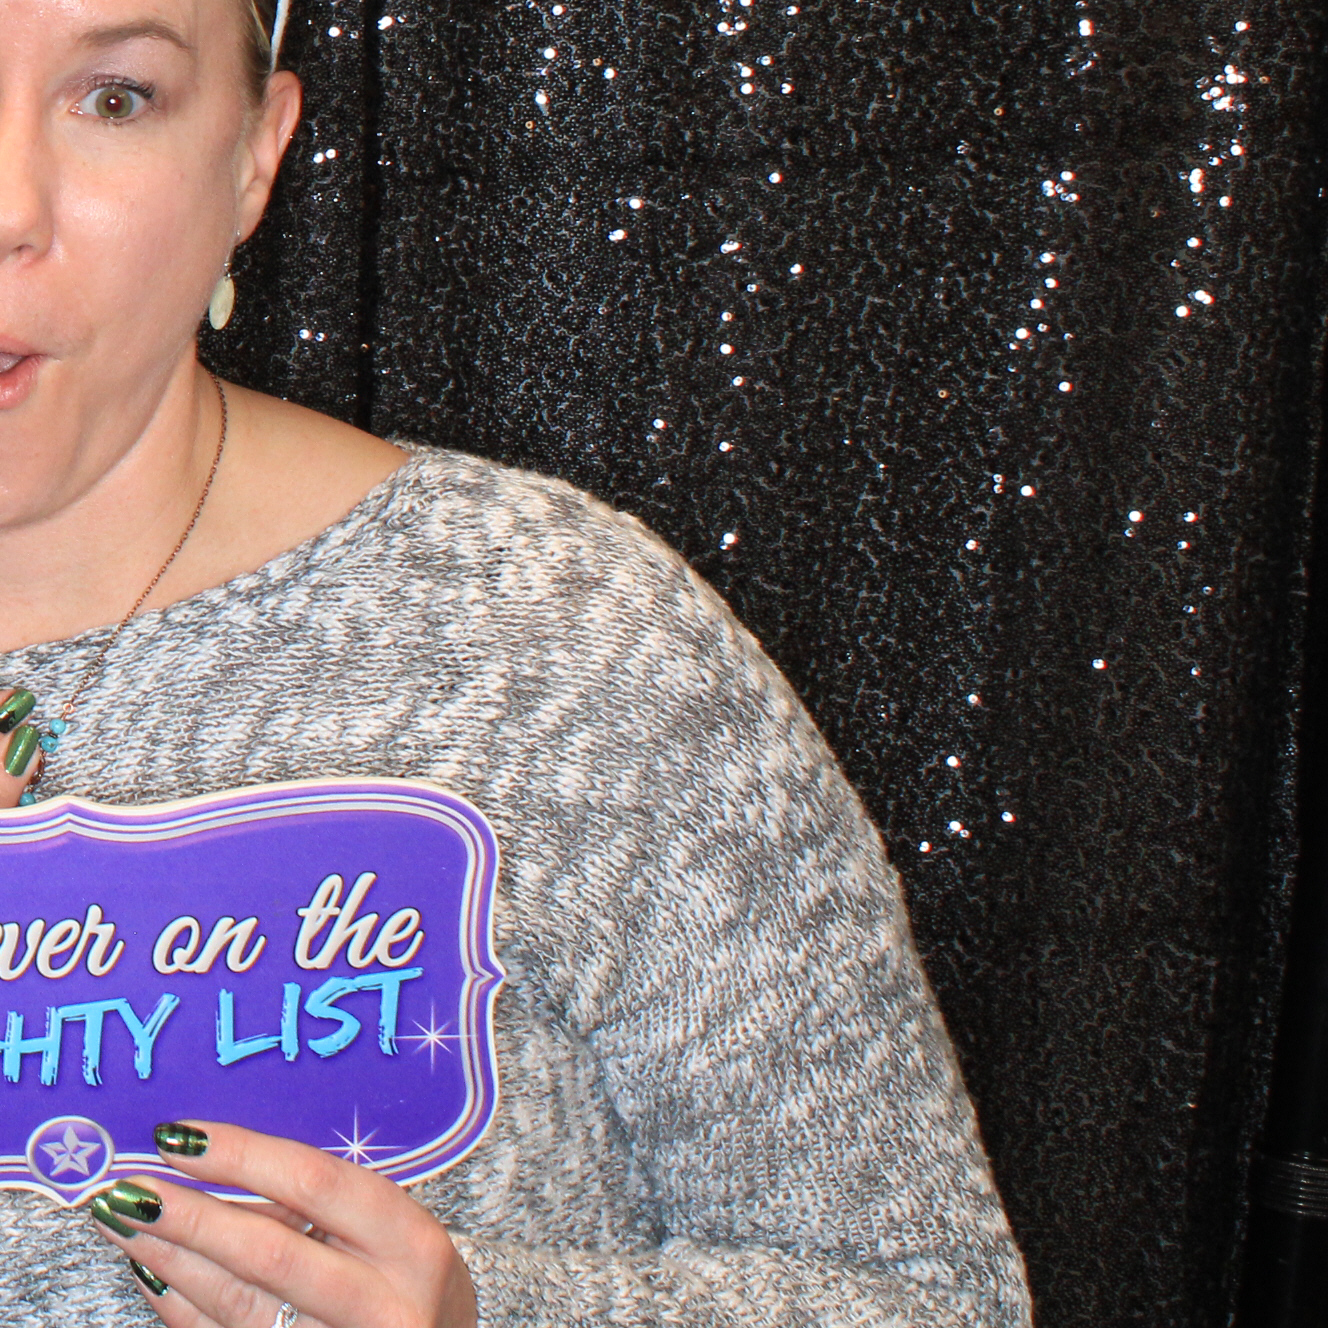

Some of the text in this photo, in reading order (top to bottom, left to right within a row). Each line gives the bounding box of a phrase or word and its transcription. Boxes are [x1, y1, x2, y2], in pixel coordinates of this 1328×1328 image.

[152, 911, 265, 975] on
[294, 872, 424, 971] the
[216, 967, 423, 1067] LIST
